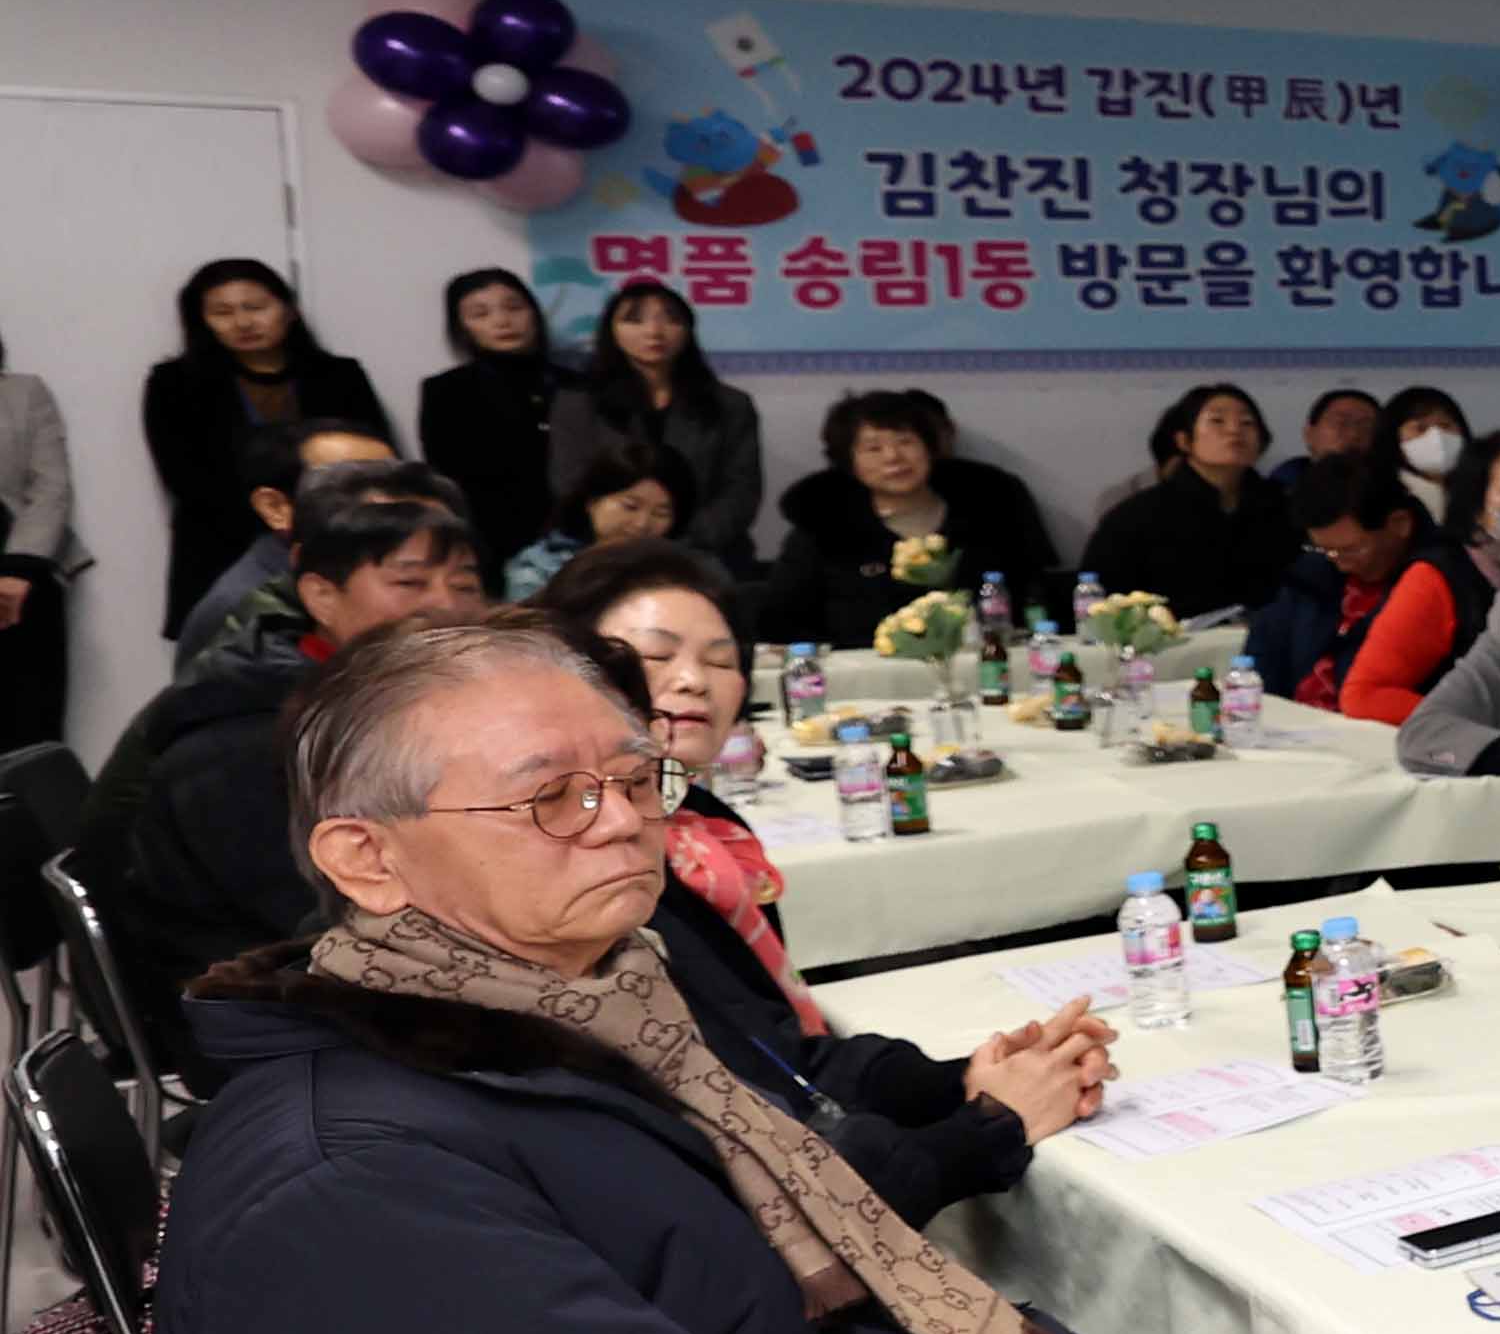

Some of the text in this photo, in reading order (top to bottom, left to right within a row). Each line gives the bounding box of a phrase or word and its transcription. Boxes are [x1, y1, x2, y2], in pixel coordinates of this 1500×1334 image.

[834, 54, 1066, 114] 2024년
[865, 151, 1386, 228] 김찬진 청장님의
[590, 235, 754, 306] 명품
[781, 236, 1035, 310] 송림1동
[1058, 241, 1256, 311] 방문을
